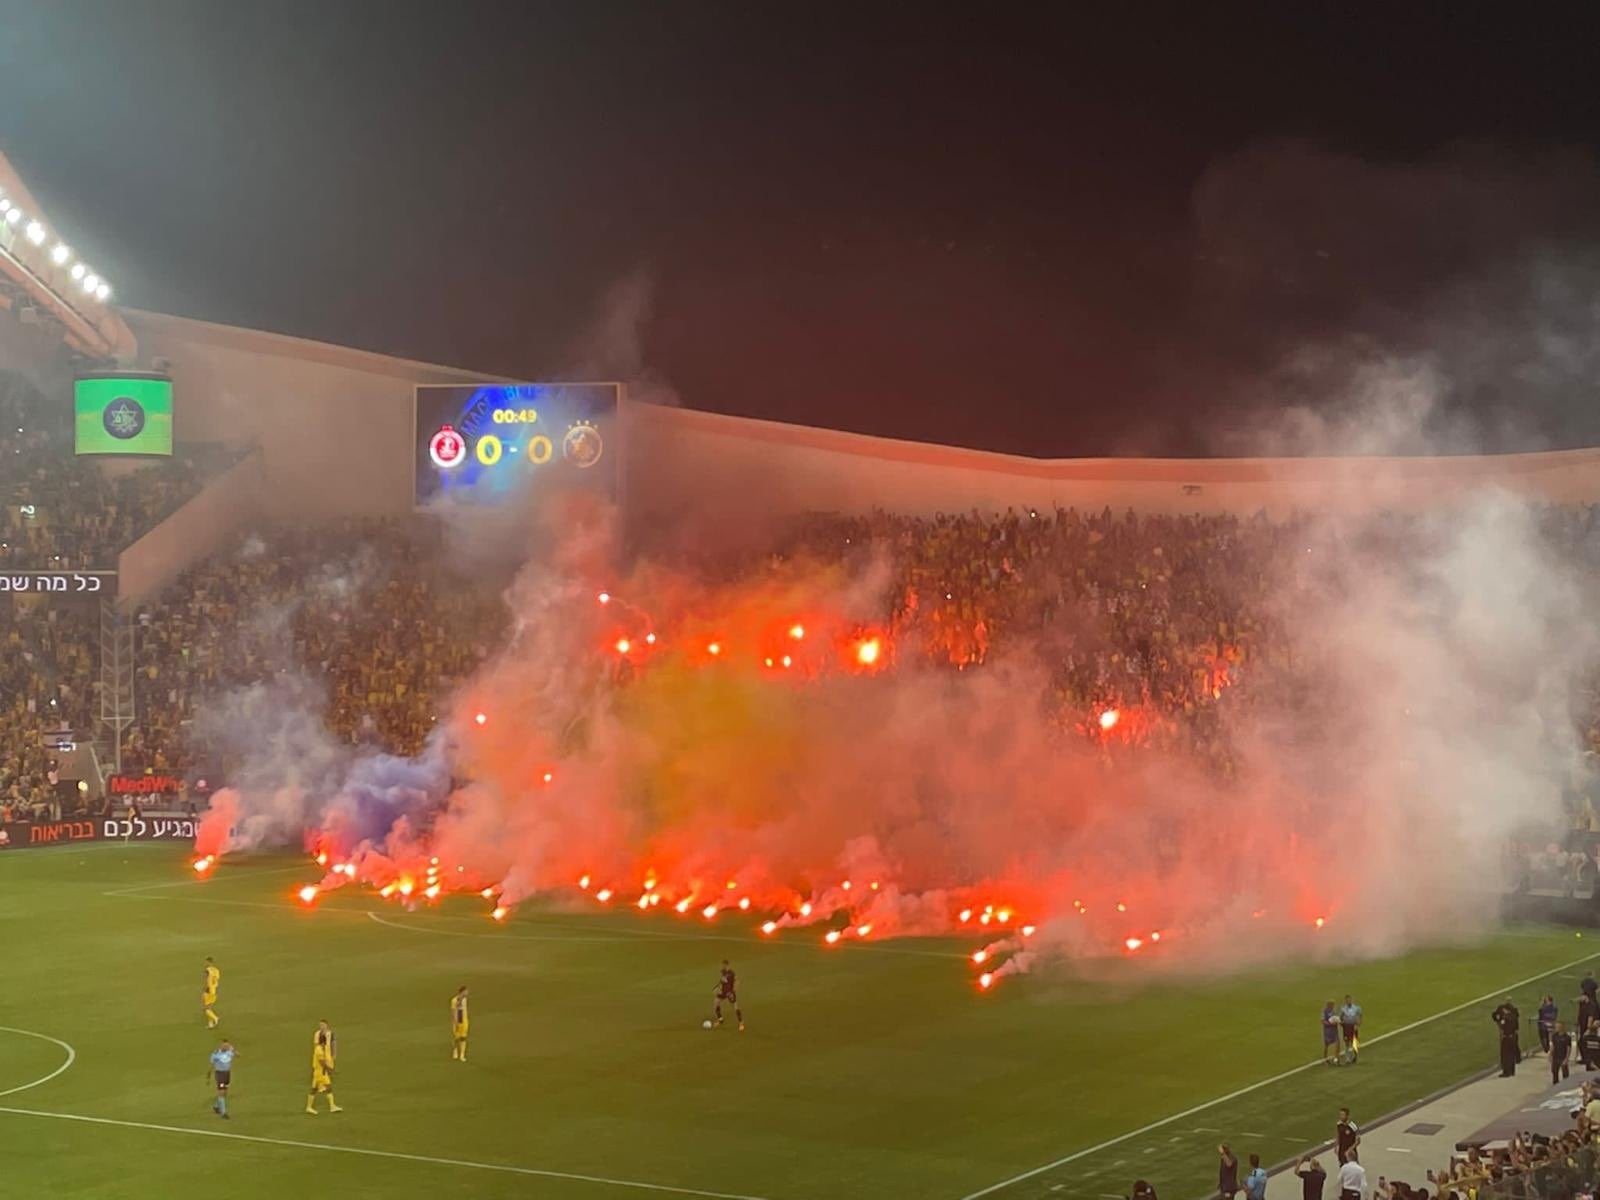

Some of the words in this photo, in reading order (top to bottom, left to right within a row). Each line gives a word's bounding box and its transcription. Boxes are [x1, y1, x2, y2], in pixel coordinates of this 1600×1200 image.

[493, 409, 537, 423] 00:49
[476, 435, 502, 465] 0
[528, 435, 552, 465] 0
[36, 576, 67, 591] מה
[73, 574, 100, 591] כל
[31, 822, 95, 843] בבריאות
[104, 818, 146, 837] לכם
